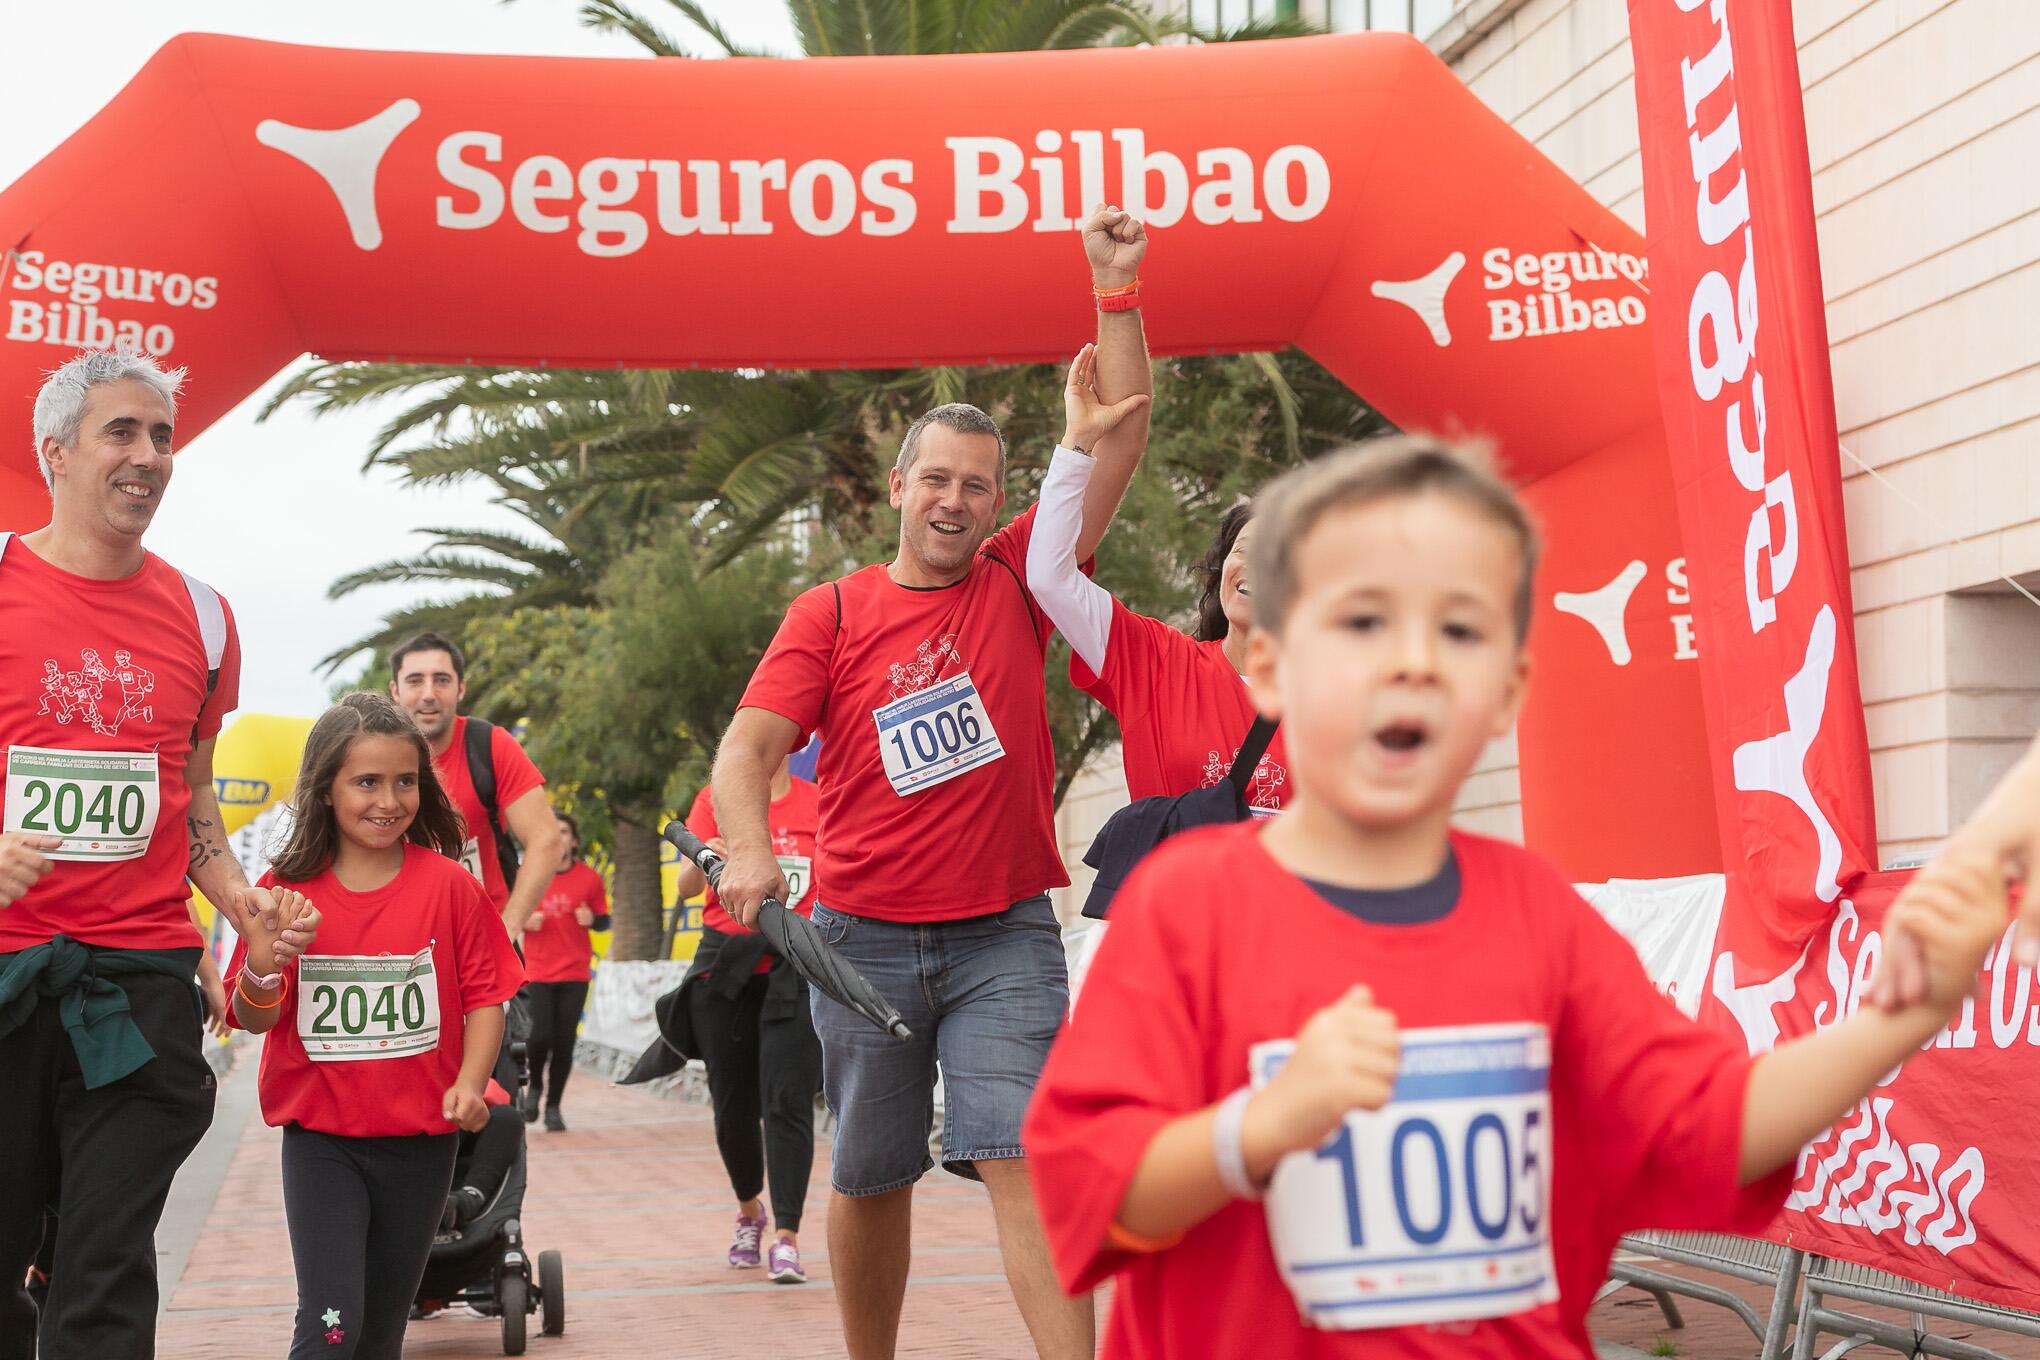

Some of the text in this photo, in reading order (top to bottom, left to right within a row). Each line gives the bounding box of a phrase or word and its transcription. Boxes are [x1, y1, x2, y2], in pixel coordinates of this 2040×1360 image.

[436, 128, 1331, 257] Seguros Bilbao
[12, 250, 219, 310] Seguros
[6, 299, 175, 357] Bilbao
[1487, 291, 1647, 341] Bilbao
[891, 702, 981, 770] 1006
[21, 780, 145, 836] 2040
[312, 982, 425, 1034] 2040
[1316, 1111, 1541, 1247] 1005
